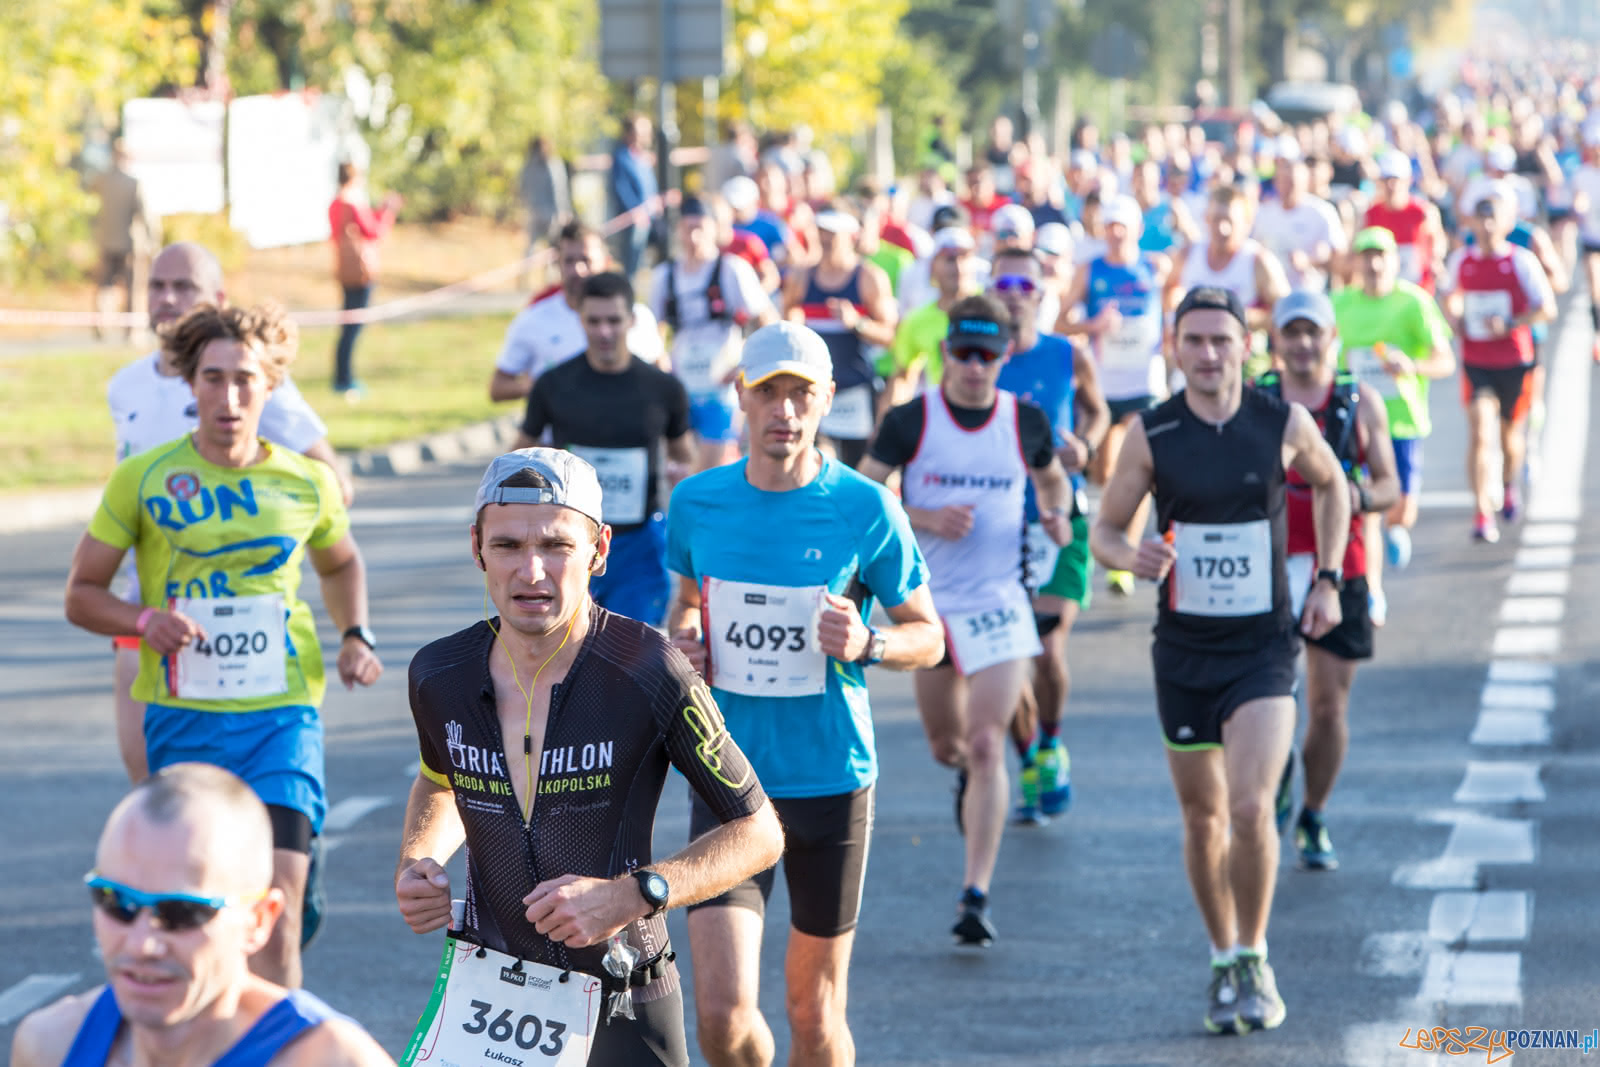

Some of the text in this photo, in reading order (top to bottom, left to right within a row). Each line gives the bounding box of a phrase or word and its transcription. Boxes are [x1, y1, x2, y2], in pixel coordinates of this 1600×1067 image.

[145, 478, 259, 531] RUN
[1192, 556, 1251, 578] 1703
[194, 631, 268, 657] 4020
[725, 621, 805, 652] 4093
[453, 770, 486, 793] ŚRODA
[462, 999, 567, 1057] 3603
[484, 1047, 524, 1067] Łukasz
